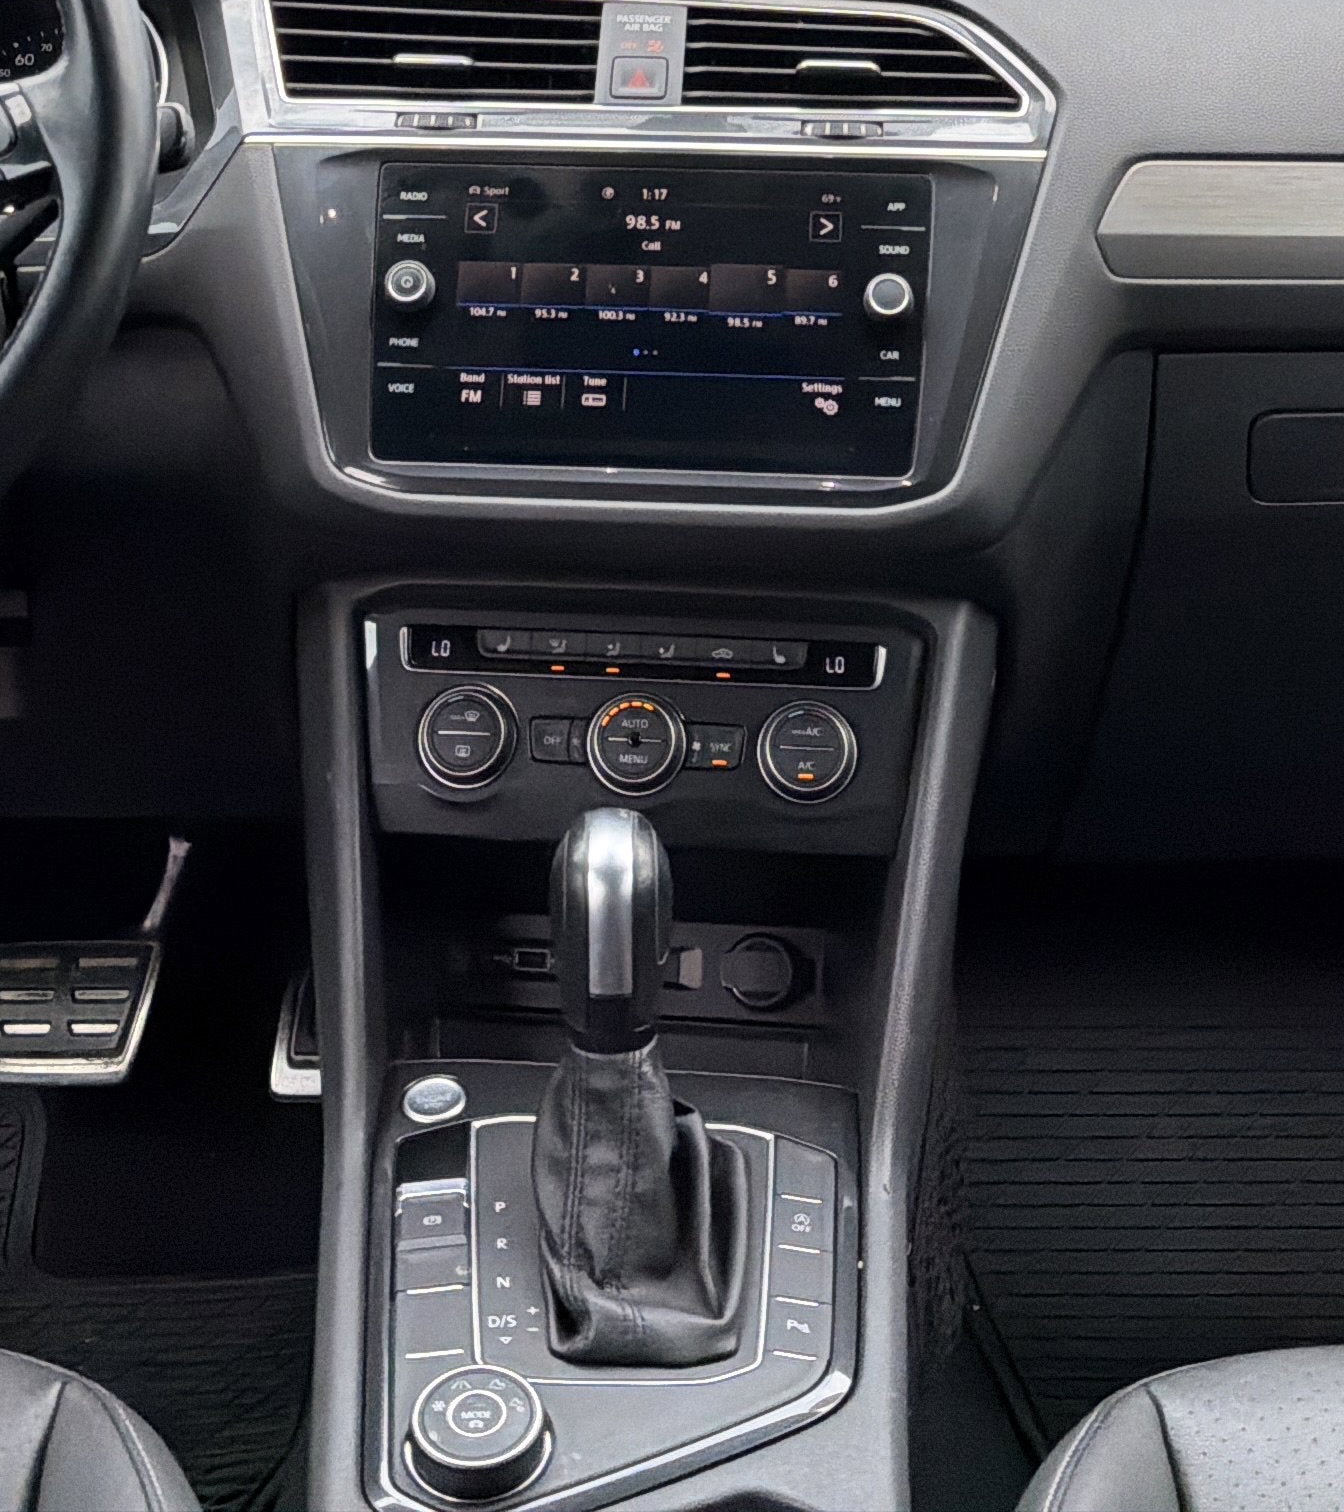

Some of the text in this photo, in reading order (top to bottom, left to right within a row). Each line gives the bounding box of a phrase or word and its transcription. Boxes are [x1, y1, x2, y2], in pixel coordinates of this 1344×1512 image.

[616, 14, 672, 24] PASSENGER
[624, 23, 663, 32] AIR BAG
[40, 43, 53, 52] 70
[15, 53, 35, 67] 60
[400, 191, 428, 201] RADIO
[641, 188, 668, 201] 1:17
[886, 202, 906, 212] APP
[625, 214, 681, 230] 98.5 FM
[397, 233, 425, 243] MEDIA
[878, 244, 910, 255] SOUND
[510, 266, 517, 280] 1
[570, 267, 580, 282] 2
[636, 269, 645, 283] 3
[698, 270, 708, 284] 4
[767, 269, 777, 285] 5
[828, 273, 839, 288] 6
[389, 337, 419, 347] PHONE
[879, 350, 900, 360] CAR
[459, 373, 486, 384] Band
[507, 373, 543, 385] Station
[583, 376, 607, 387] Tune
[388, 383, 415, 393] VOICE
[801, 382, 843, 395] Settings
[460, 390, 483, 403] FM
[874, 397, 902, 408] MENU
[431, 639, 451, 657] LO
[825, 656, 845, 674] LO
[621, 718, 649, 728] AUTO
[710, 742, 733, 753] SYNC
[619, 753, 648, 764] MENU
[797, 760, 815, 770] A/C
[495, 1201, 506, 1213] P
[496, 1237, 508, 1249] R
[496, 1276, 511, 1289] N
[487, 1314, 517, 1328] D/S
